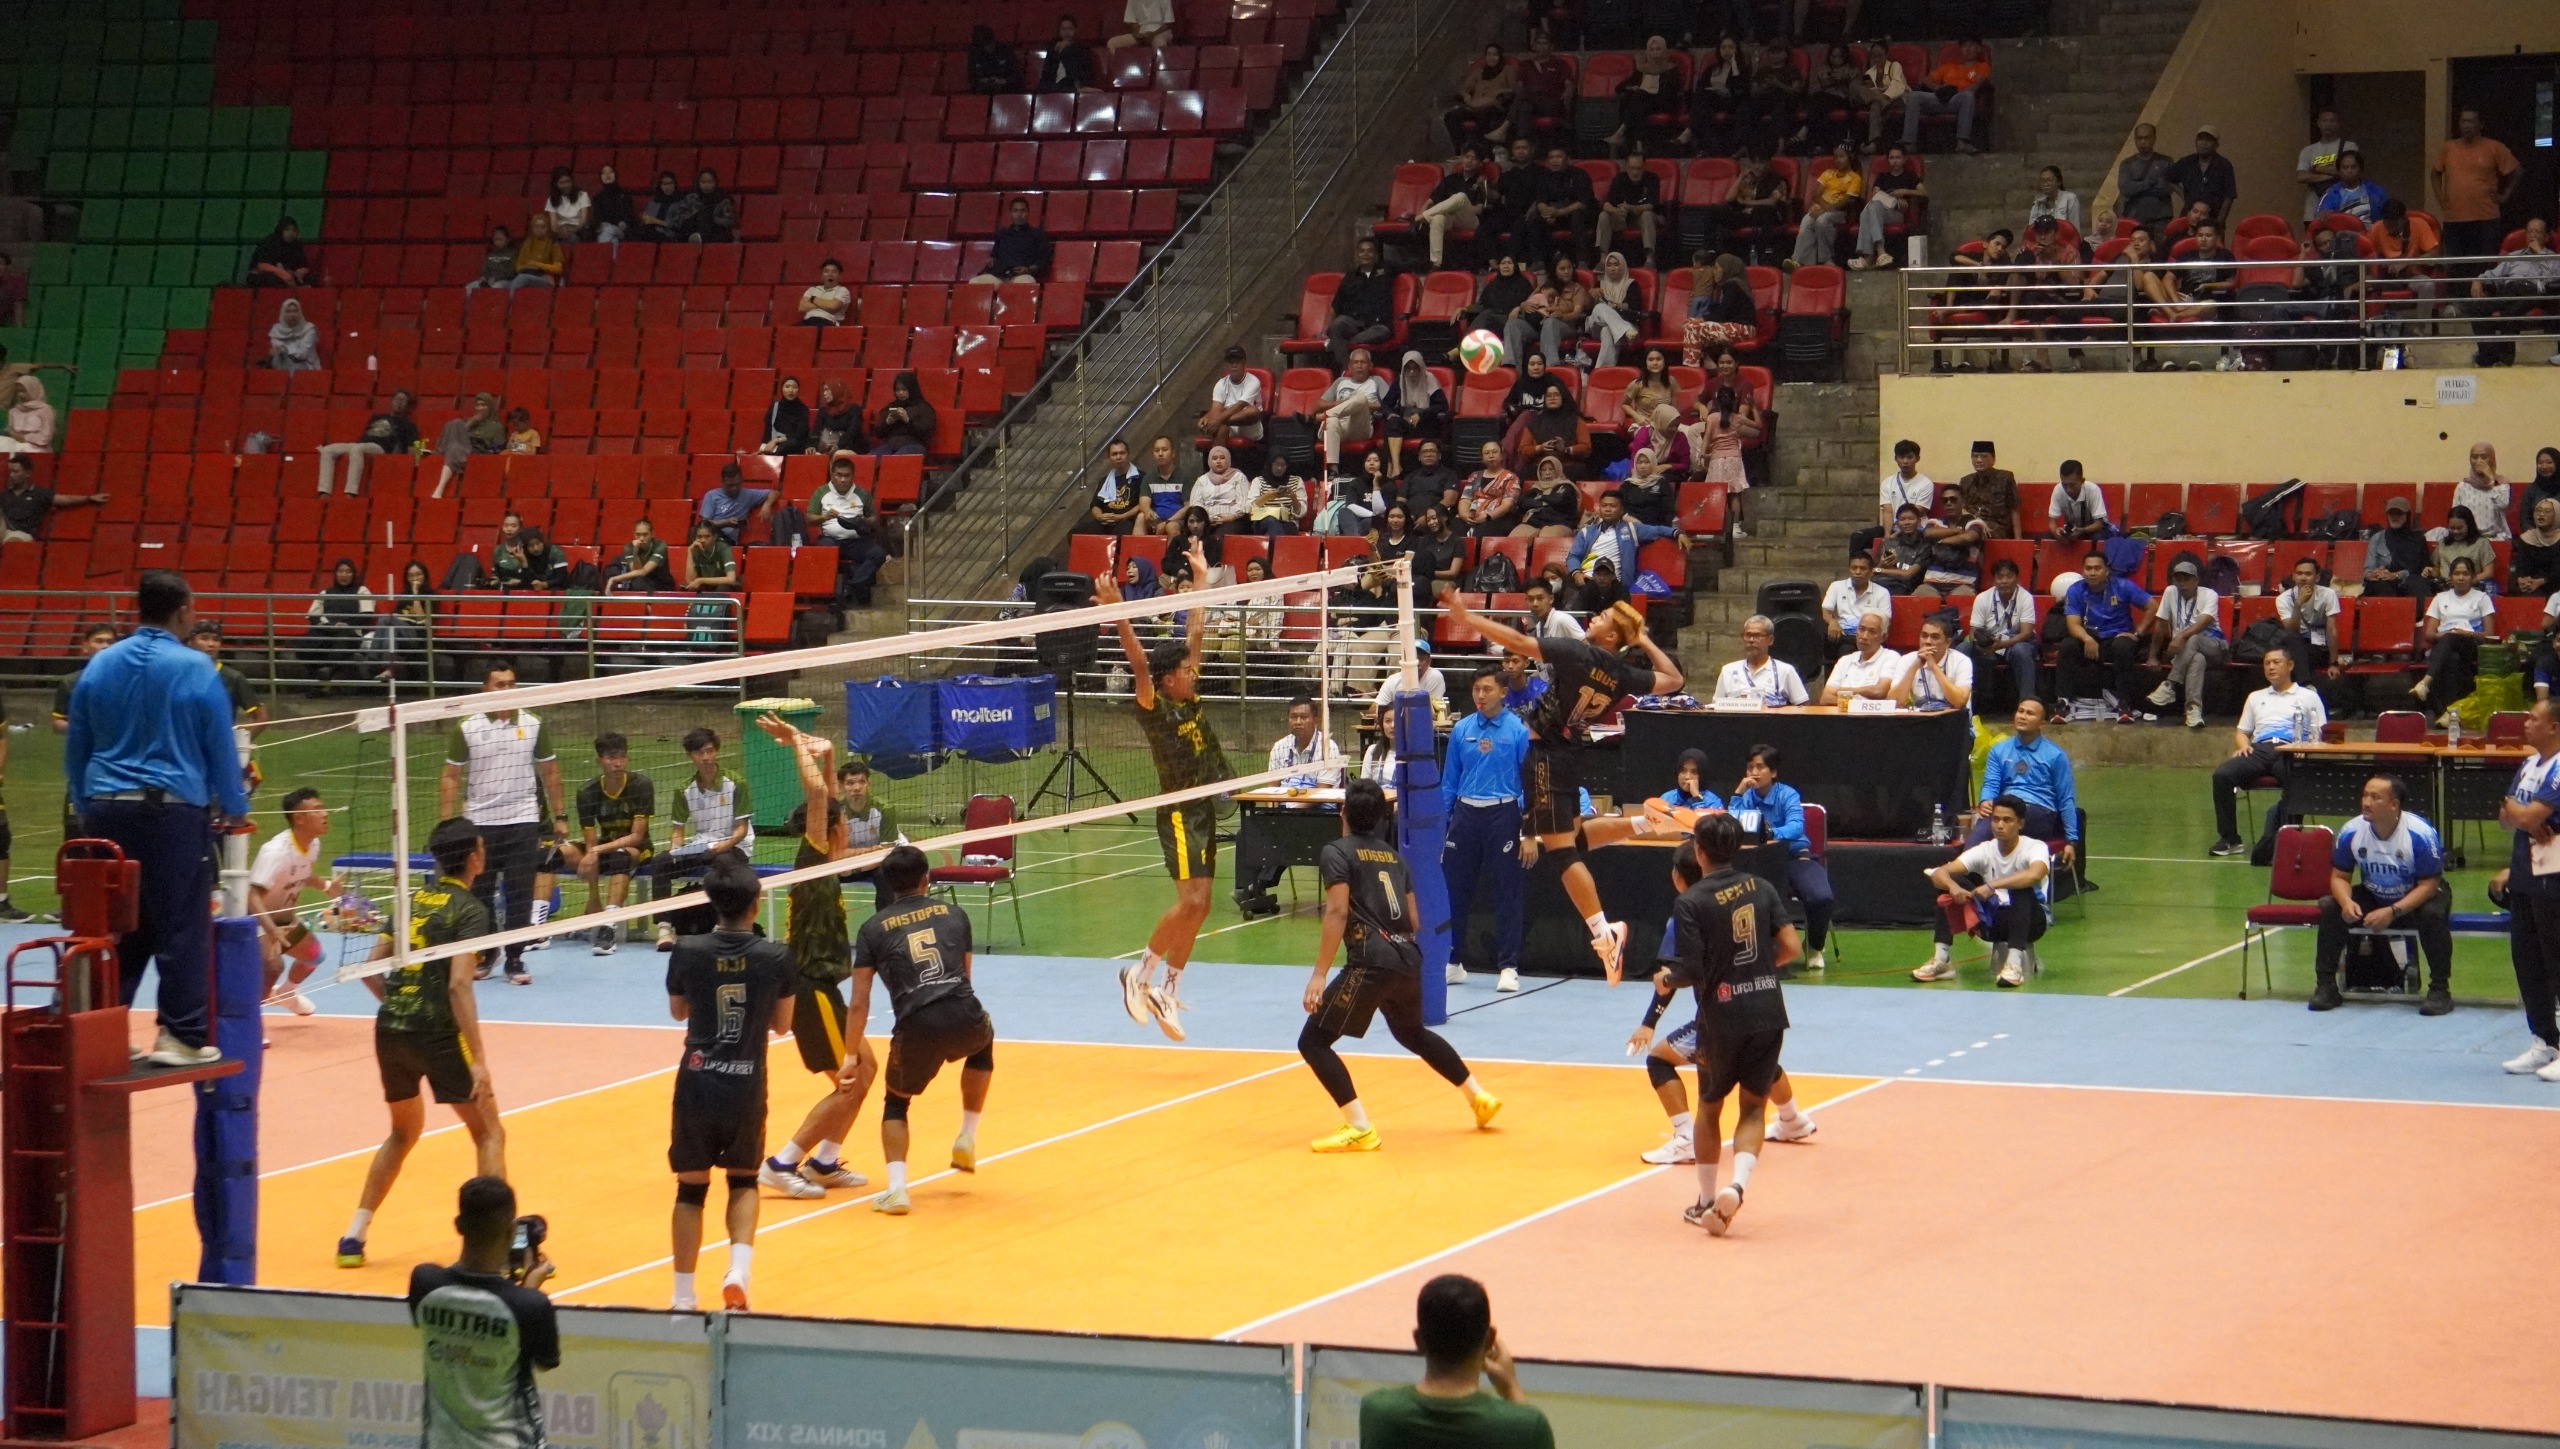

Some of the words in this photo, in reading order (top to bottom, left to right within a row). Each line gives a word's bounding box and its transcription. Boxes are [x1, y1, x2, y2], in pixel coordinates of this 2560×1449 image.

[951, 707, 1013, 723] molten
[1861, 703, 1882, 711] RSC
[1739, 812, 1756, 832] 10
[1379, 871, 1402, 920] 1
[881, 904, 949, 932] TRISTOPER
[1731, 903, 1758, 966] 9
[907, 927, 945, 983] 5
[1732, 981, 1754, 995] LIFCO
[1754, 978, 1777, 991] JERSEY
[716, 983, 747, 1043] 6
